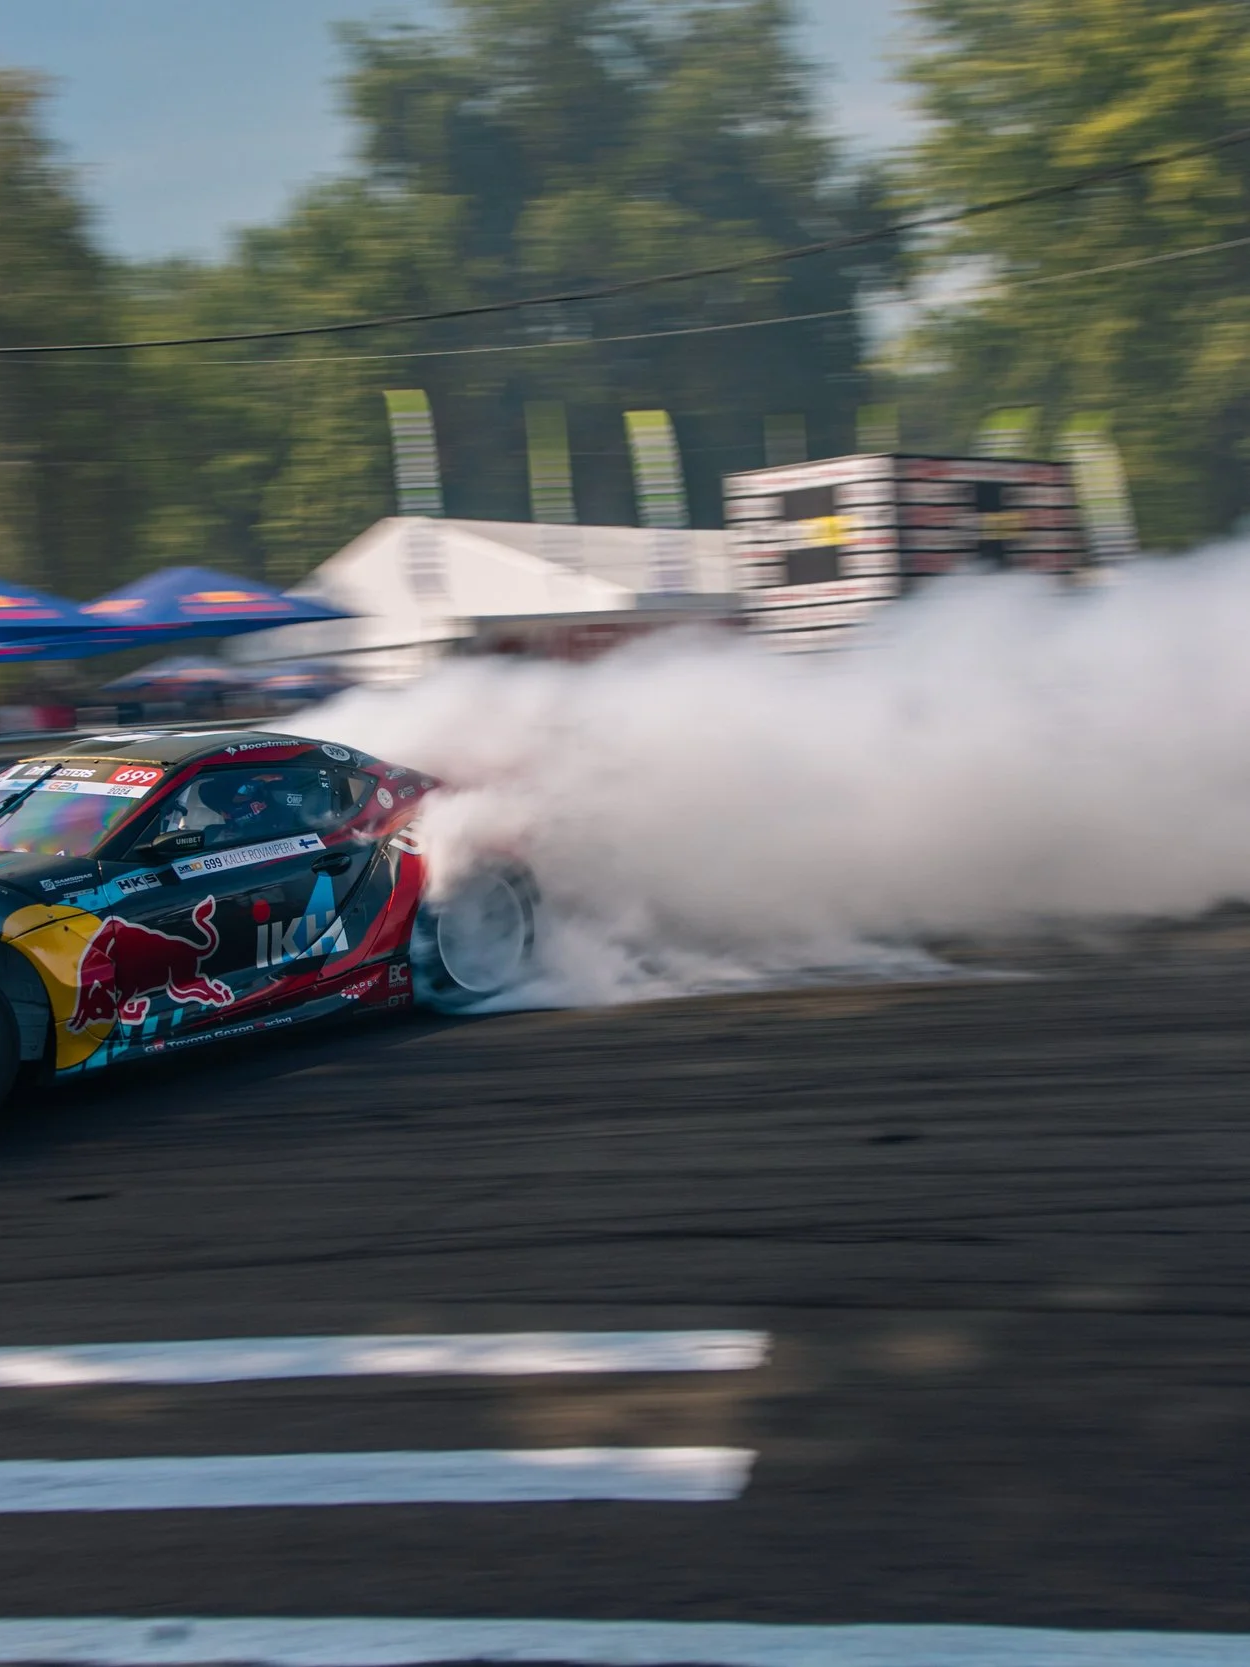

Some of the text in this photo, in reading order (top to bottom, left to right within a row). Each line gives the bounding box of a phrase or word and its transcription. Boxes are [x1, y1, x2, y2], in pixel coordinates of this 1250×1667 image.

[239, 740, 300, 751] Boostmark
[115, 770, 158, 784] 699
[49, 782, 79, 791] G2A
[107, 787, 130, 796] 2024
[287, 795, 303, 804] OMP
[175, 836, 202, 846] UNIBET
[204, 857, 223, 870] 699
[223, 850, 249, 866] KALLE
[54, 873, 93, 884] SAMSONAS
[117, 873, 158, 891] HKS
[389, 963, 408, 983] BC
